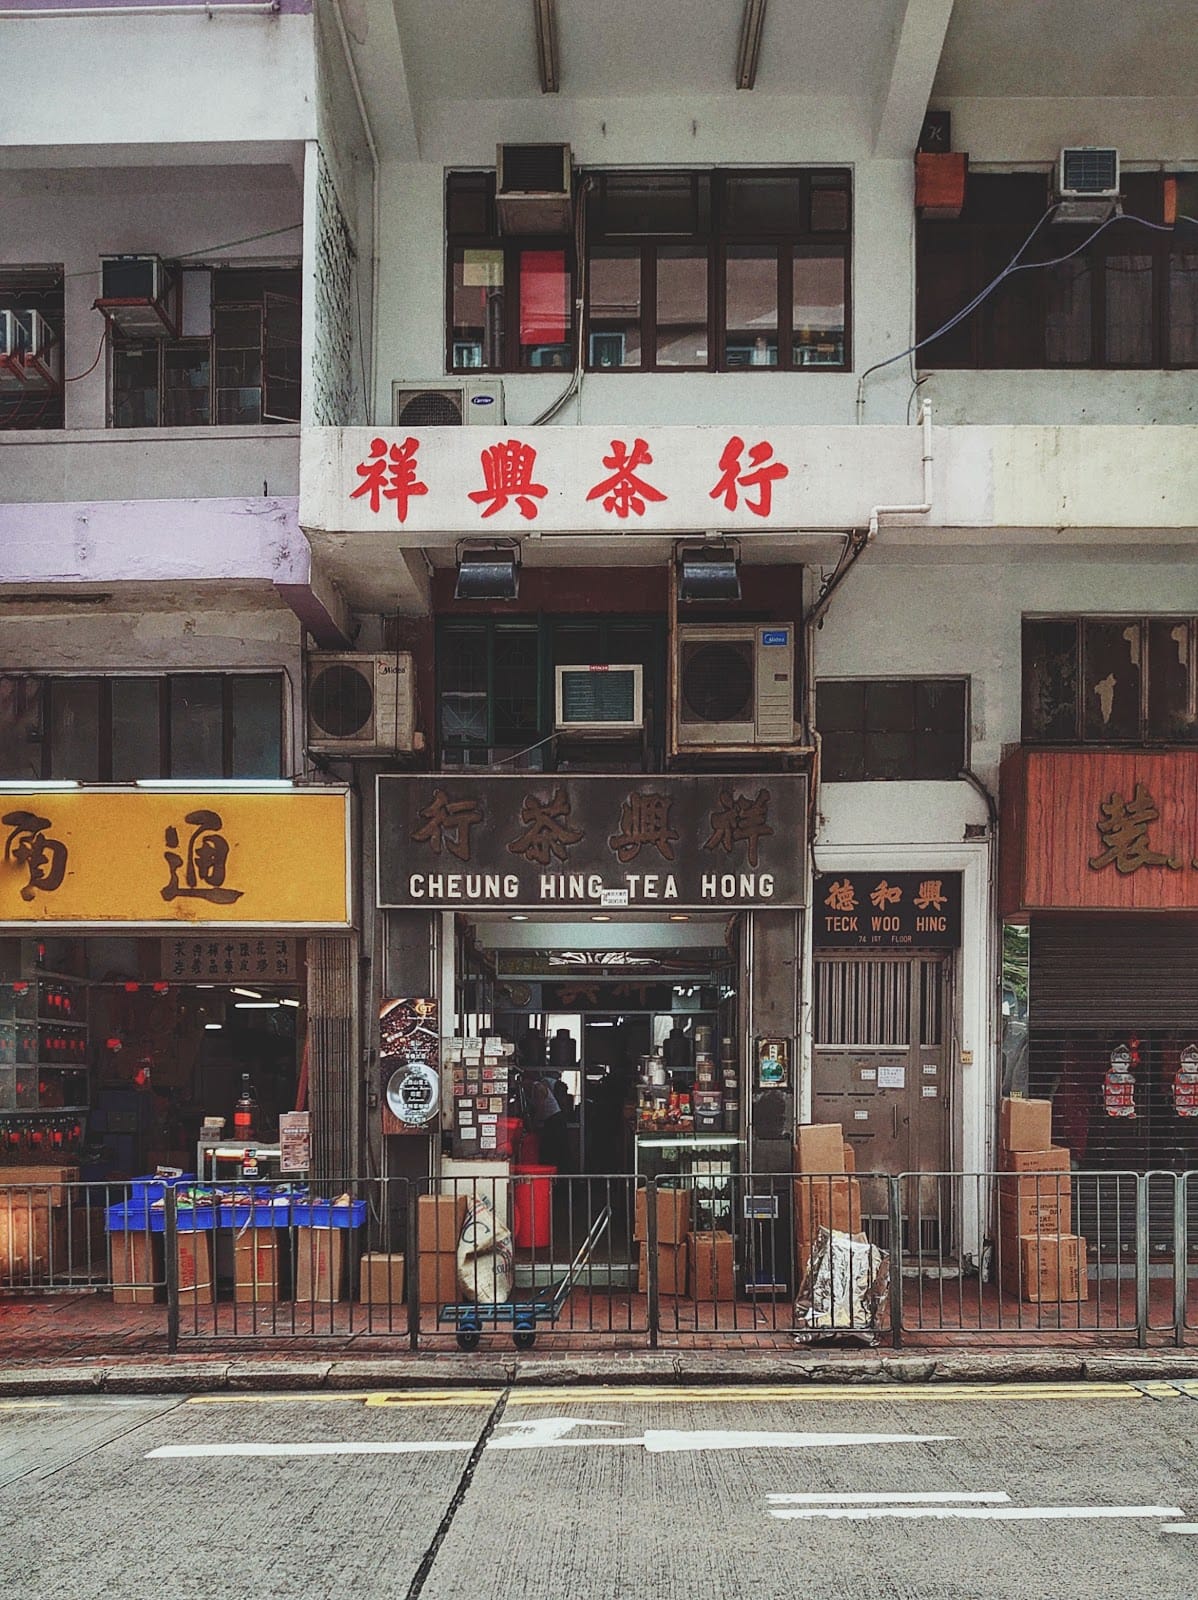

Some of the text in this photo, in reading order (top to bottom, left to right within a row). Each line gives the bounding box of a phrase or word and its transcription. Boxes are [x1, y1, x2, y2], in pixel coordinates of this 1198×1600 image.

[351, 437, 789, 523] 祥興茶行
[409, 874, 519, 898] CHEUNG
[540, 874, 603, 898] HING
[626, 874, 679, 898] TEA
[701, 874, 775, 898] HONG
[825, 916, 947, 932] TECK WOO HING
[891, 935, 912, 943] FLOOR
